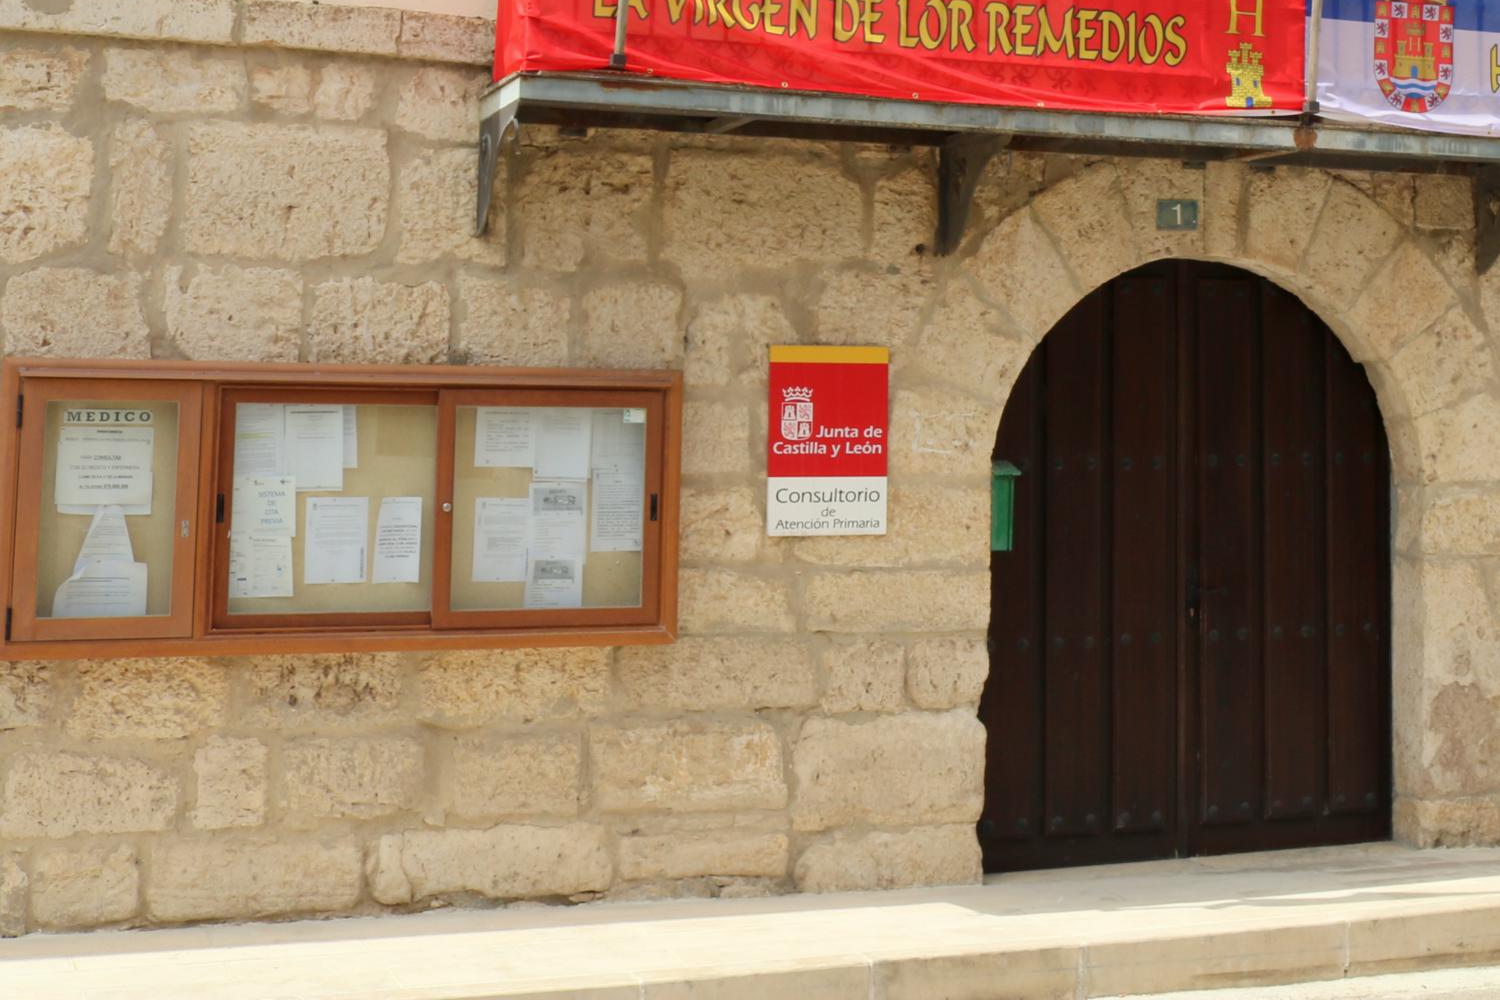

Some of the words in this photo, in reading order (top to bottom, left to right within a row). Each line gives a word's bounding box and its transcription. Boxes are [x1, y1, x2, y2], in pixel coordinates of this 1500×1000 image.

[984, 1, 1188, 67] REMEDIOS
[1171, 203, 1181, 225] 1
[67, 411, 151, 422] MEDICO
[816, 426, 859, 439] Junta
[863, 426, 883, 438] de
[773, 441, 827, 455] Castilla
[830, 444, 840, 458] y
[845, 441, 882, 455] León
[775, 487, 880, 504] Consultorio
[820, 507, 836, 517] de
[775, 519, 829, 530] Atención
[833, 518, 880, 529] Primaria
